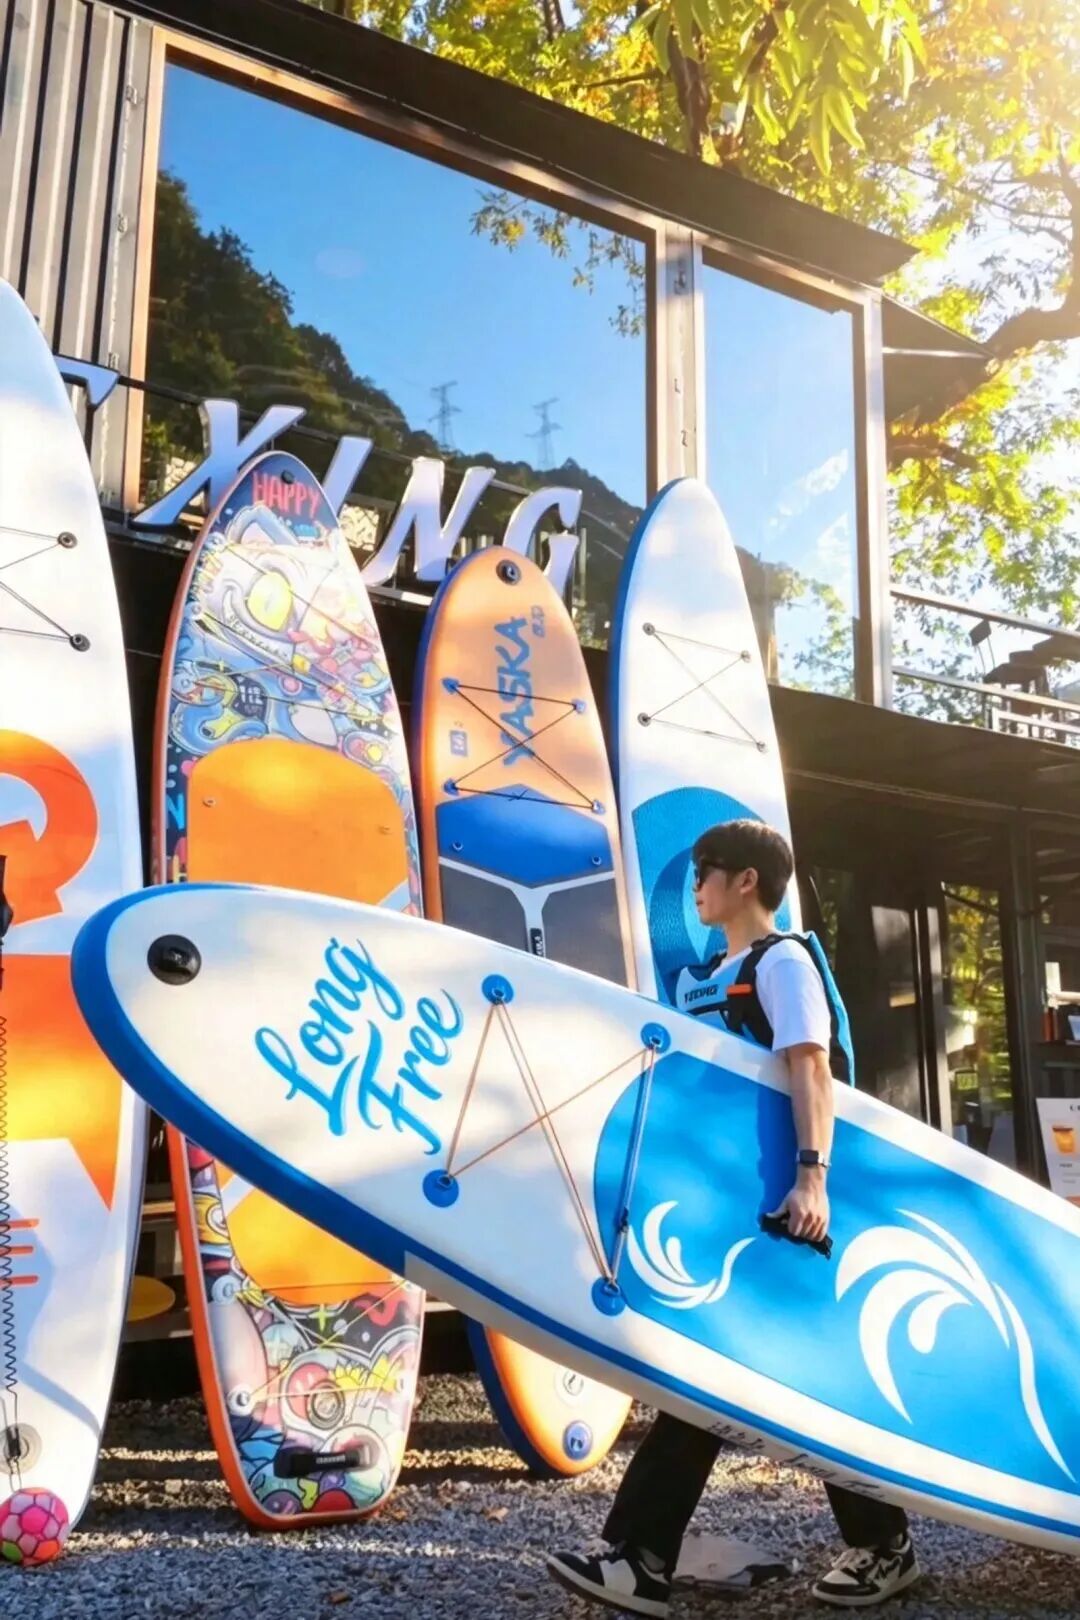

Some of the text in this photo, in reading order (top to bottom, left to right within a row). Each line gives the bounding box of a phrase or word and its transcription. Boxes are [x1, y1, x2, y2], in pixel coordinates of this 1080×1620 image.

[252, 470, 321, 519] HAPPY
[495, 615, 536, 767] YASKA
[255, 937, 405, 1137] Long
[358, 987, 464, 1156] Free
